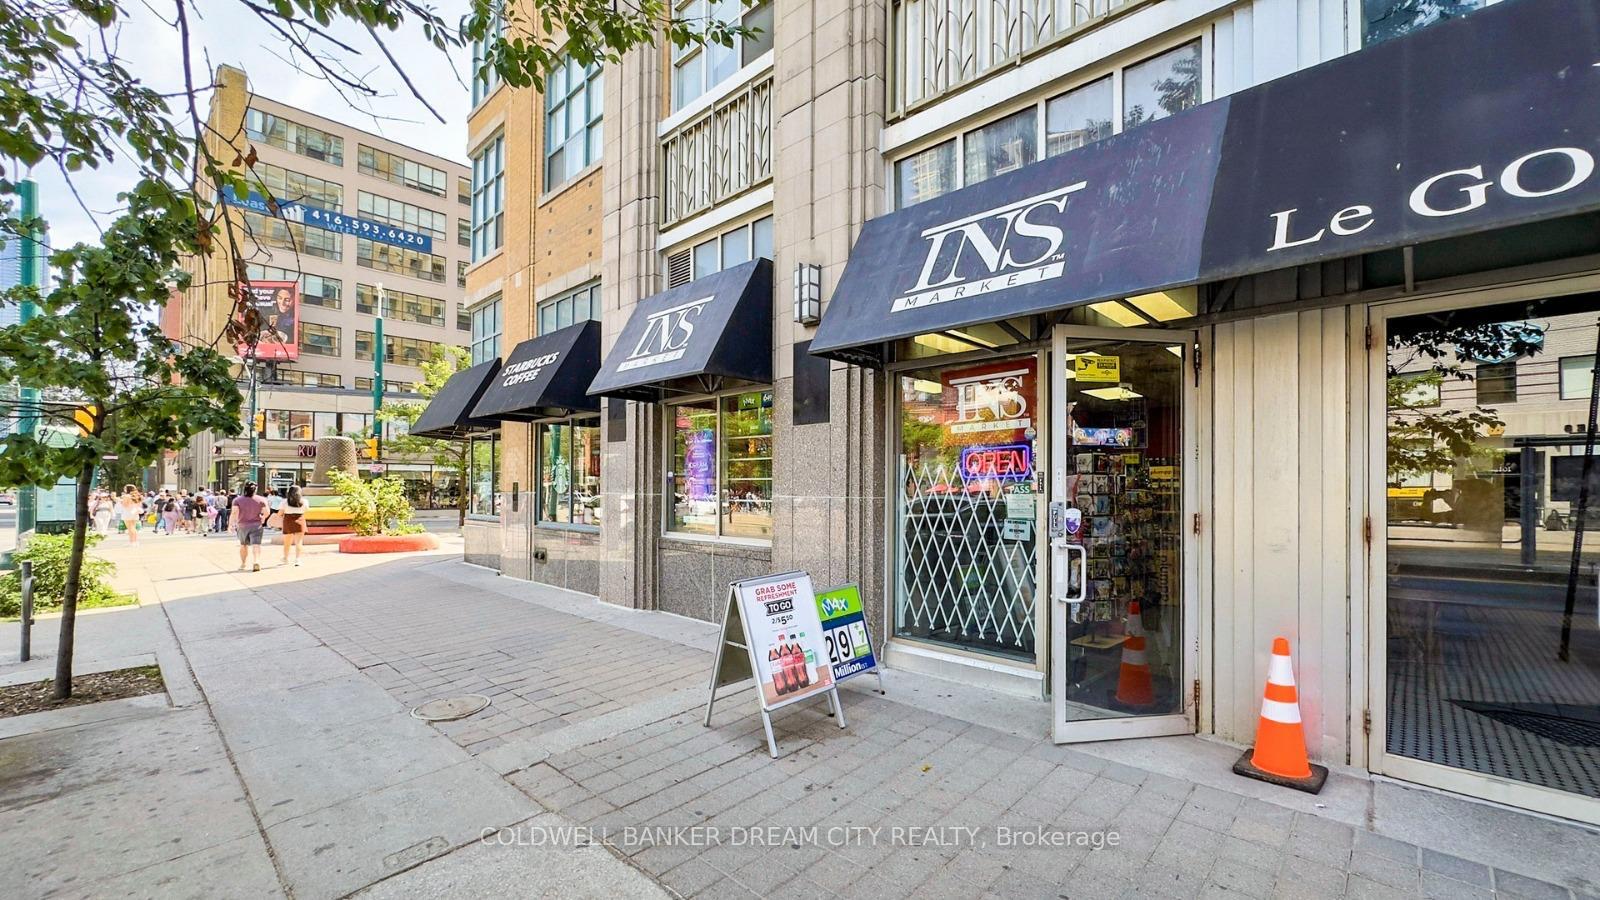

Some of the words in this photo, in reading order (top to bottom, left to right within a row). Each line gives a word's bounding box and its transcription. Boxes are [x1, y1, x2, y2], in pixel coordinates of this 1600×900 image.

[312, 209, 424, 246] 416.593.6420
[1267, 205, 1375, 251] Le
[904, 195, 1068, 294] INS
[904, 267, 1051, 308] MARKET
[626, 303, 705, 360] INS
[502, 351, 560, 377] STARBUCKS
[502, 368, 541, 387] COFFEE
[953, 375, 1027, 422] INS
[957, 420, 1025, 432] MARKET
[966, 450, 1026, 474] OPEN
[1009, 484, 1030, 494] PASS
[755, 585, 776, 596] GRAB
[777, 582, 797, 592] SOME
[756, 589, 798, 602] REFRESHMENT
[769, 604, 779, 612] TO
[780, 601, 791, 610] GO
[834, 662, 861, 678] Million
